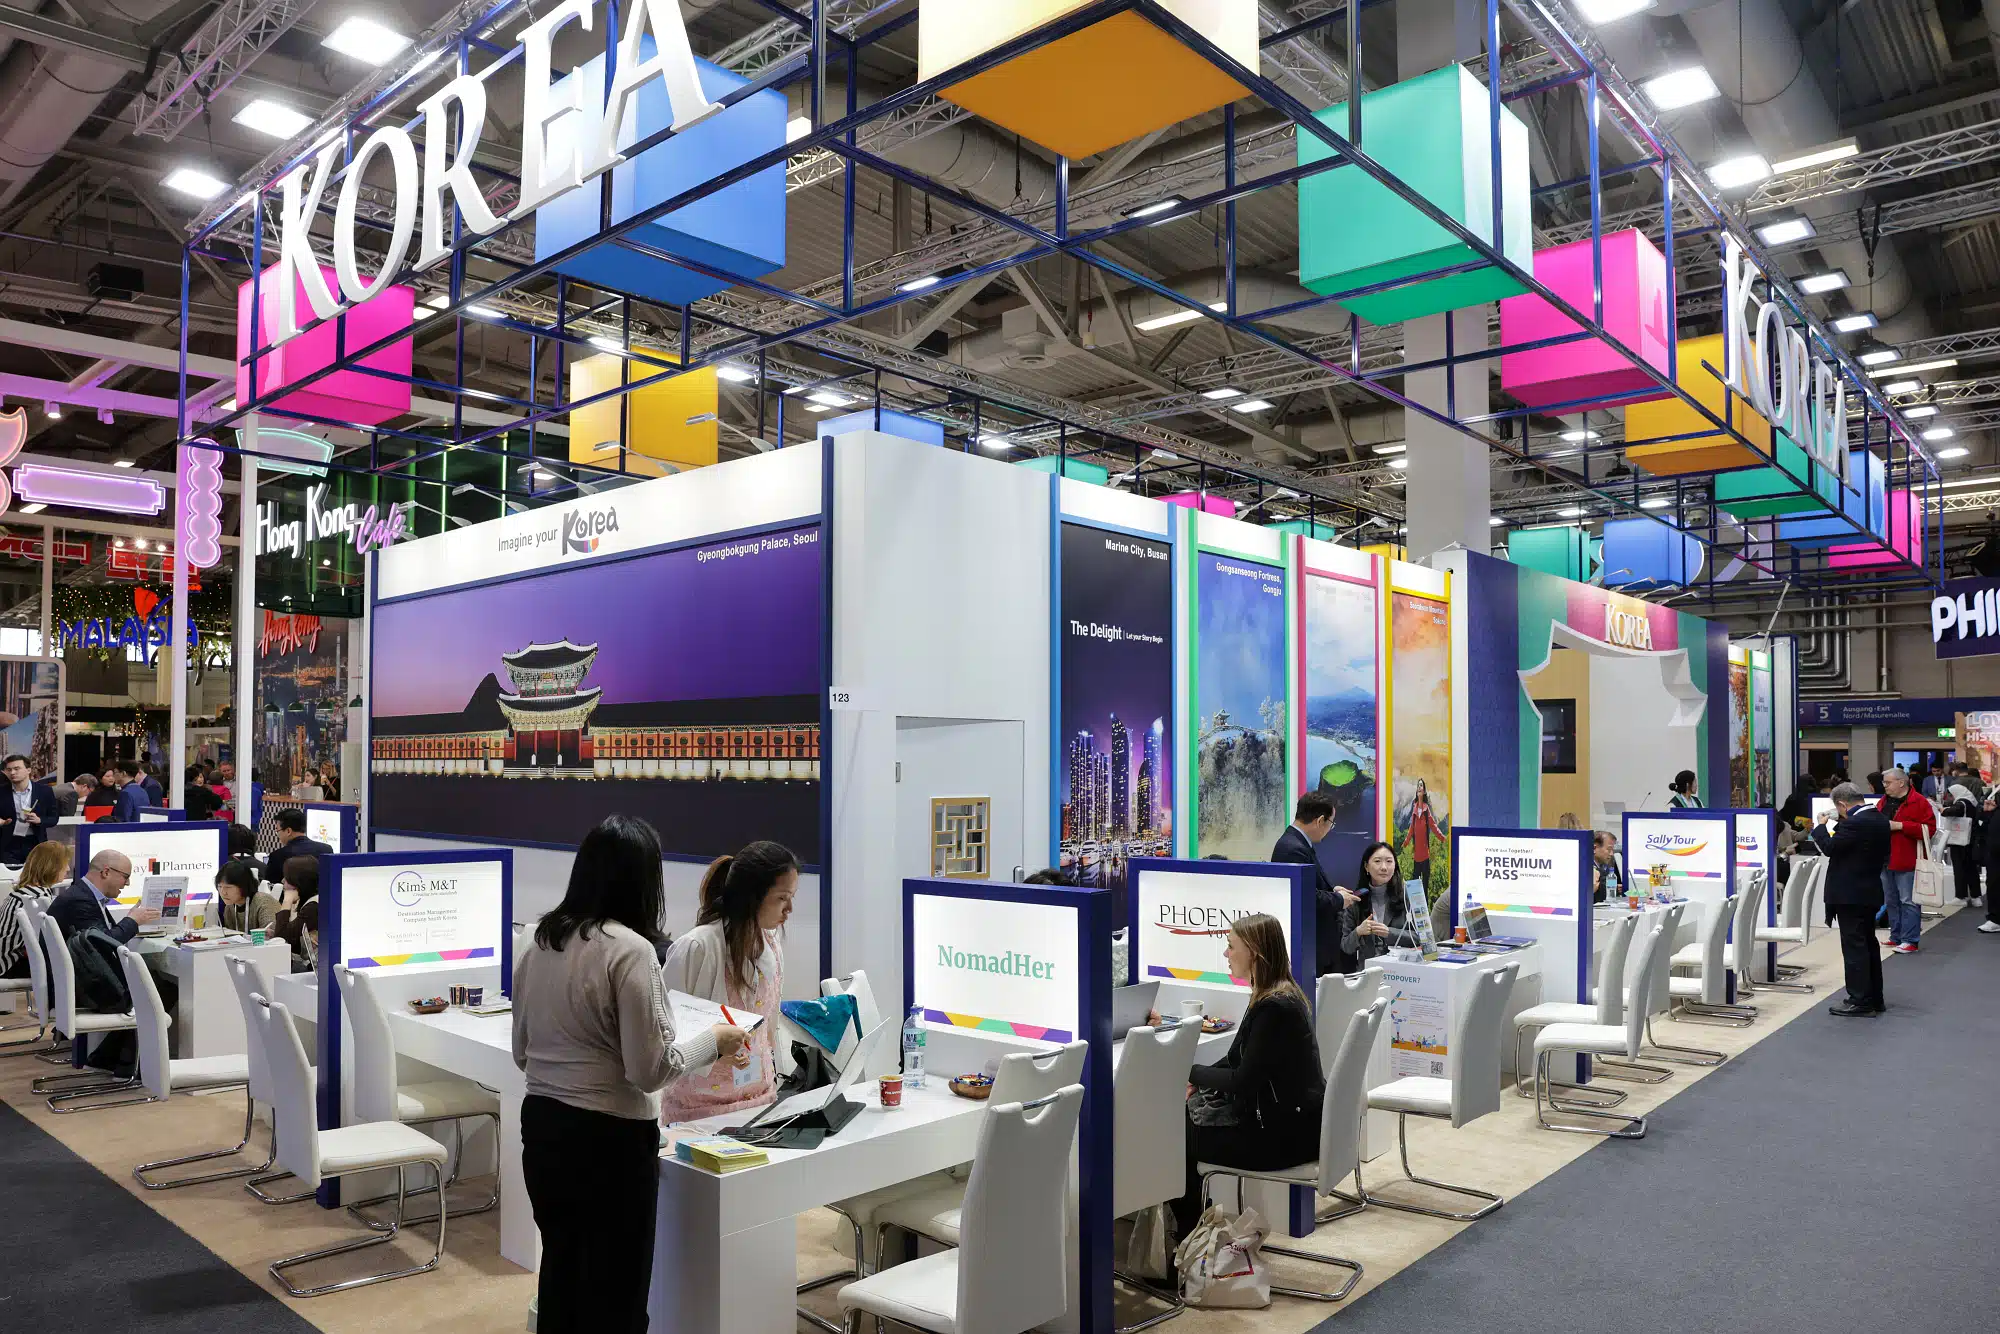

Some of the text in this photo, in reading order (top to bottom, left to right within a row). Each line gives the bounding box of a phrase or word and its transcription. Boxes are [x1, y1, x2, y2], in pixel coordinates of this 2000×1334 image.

[273, 0, 725, 348] KOREA
[1721, 231, 1850, 485] KOREA
[256, 500, 302, 559] Hong
[306, 482, 356, 544] Kong
[498, 505, 620, 556] Imagine your Korea
[697, 530, 818, 563] Gyeongbokgung Palace, Seoul
[1105, 539, 1168, 561] Marine City, Busan
[1216, 562, 1282, 584] Gongsanseong Fortress,
[1262, 584, 1282, 597] Gongju
[1931, 587, 2000, 643] PHI
[1070, 620, 1089, 637] The
[1090, 622, 1122, 643] Delight
[1142, 634, 1153, 643] Story
[1153, 635, 1163, 644] Begin
[1602, 603, 1654, 651] KOREA
[832, 693, 850, 703] 123
[1819, 706, 1829, 719] 5
[1645, 834, 1696, 849] Sally Tour
[162, 861, 213, 872] Planners
[1485, 856, 1552, 870] PREMIUM
[1485, 868, 1519, 881] PASS
[397, 879, 458, 893] Kim's M&T
[937, 943, 1055, 981] NomadHer
[1382, 973, 1421, 984] STOPOVER?
